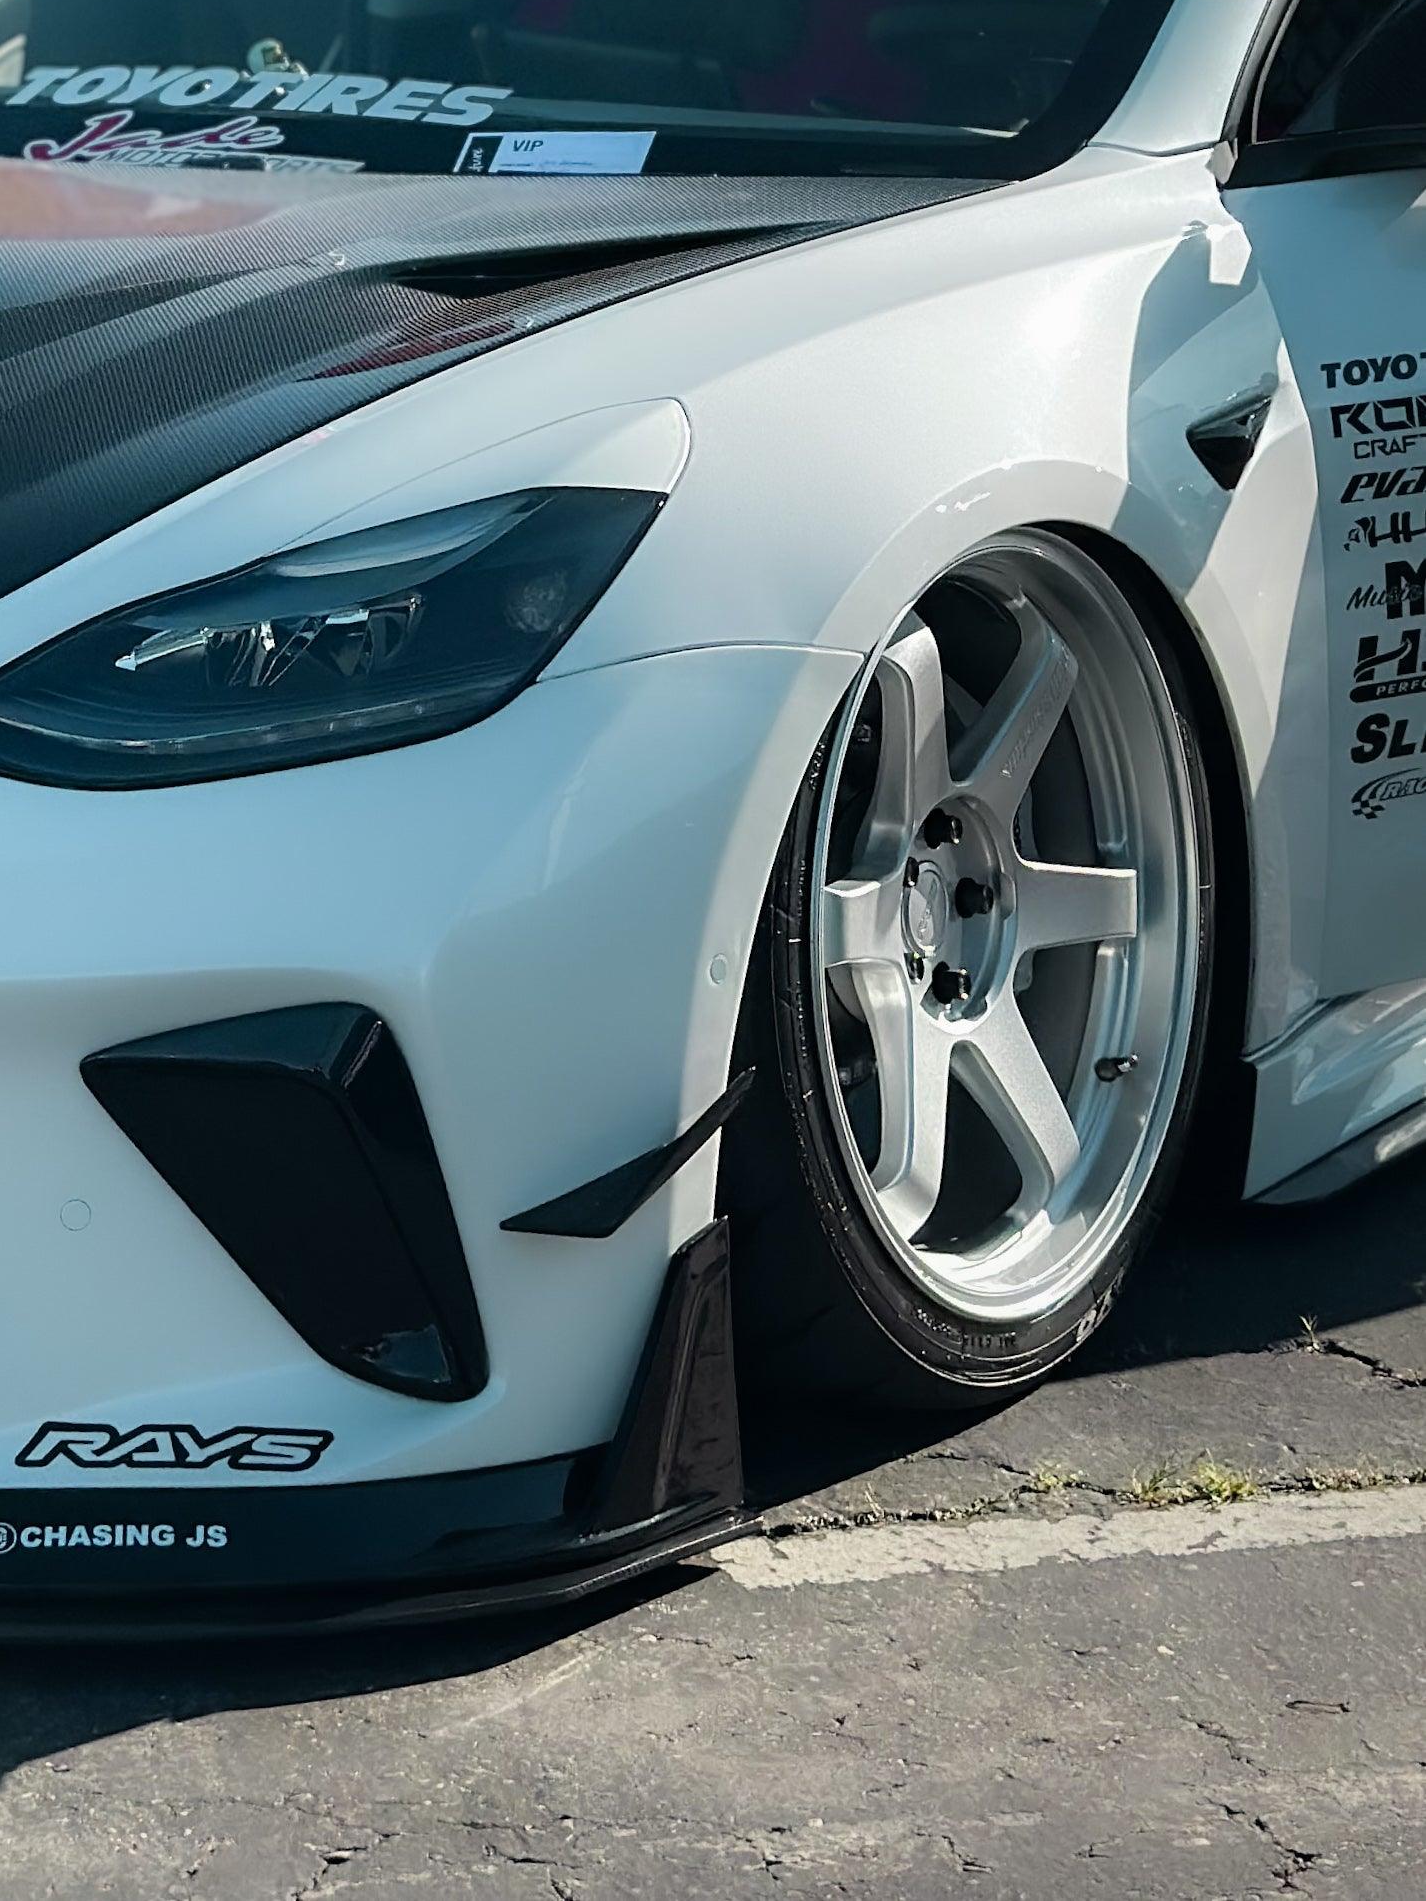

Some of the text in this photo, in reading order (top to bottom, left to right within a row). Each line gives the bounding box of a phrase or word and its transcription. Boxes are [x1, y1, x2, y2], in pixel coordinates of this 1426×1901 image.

[7, 65, 514, 126] TOYO TIRES
[24, 108, 286, 163] Jade
[512, 139, 544, 152] VIP
[15, 1421, 334, 1472] RAYS
[19, 1524, 176, 1548] CHASING
[185, 1525, 228, 1548] JS
